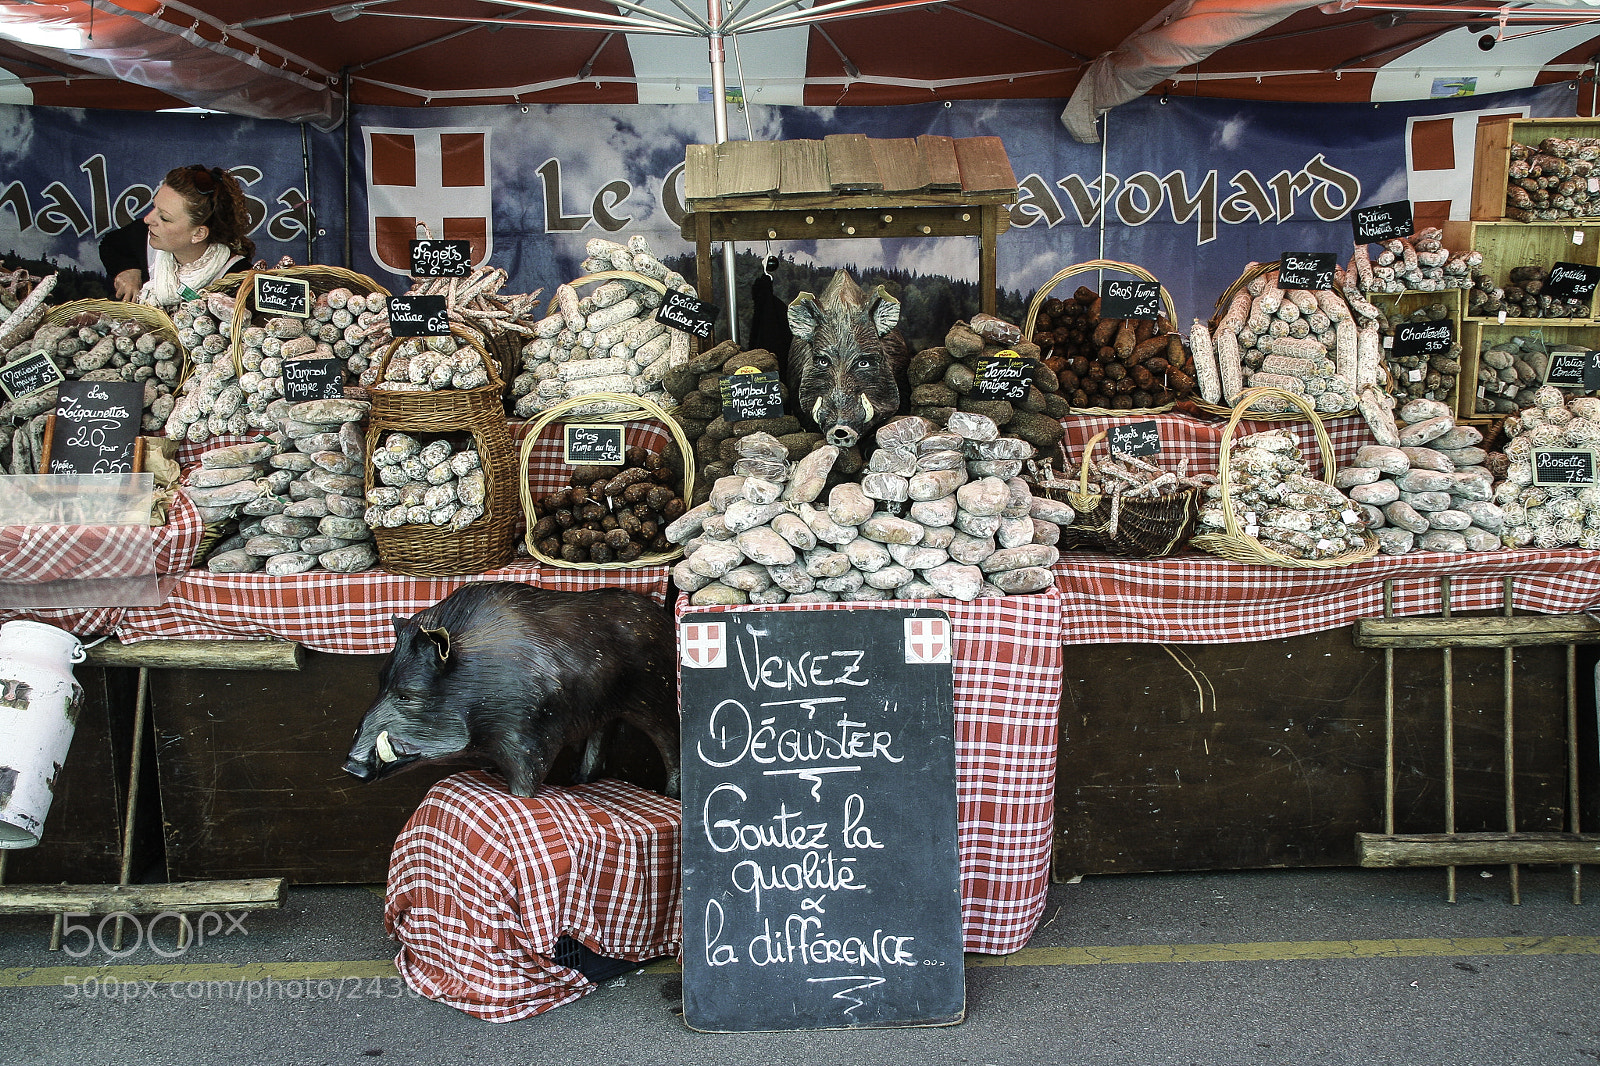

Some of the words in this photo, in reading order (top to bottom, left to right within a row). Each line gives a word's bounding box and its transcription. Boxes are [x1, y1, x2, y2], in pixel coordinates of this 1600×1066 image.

[535, 157, 633, 233] Le
[1005, 153, 1361, 246] avoyard
[66, 426, 106, 448] 20
[575, 428, 599, 441] Gros
[843, 794, 885, 849] la
[732, 850, 866, 912] qualité
[705, 898, 739, 966] la
